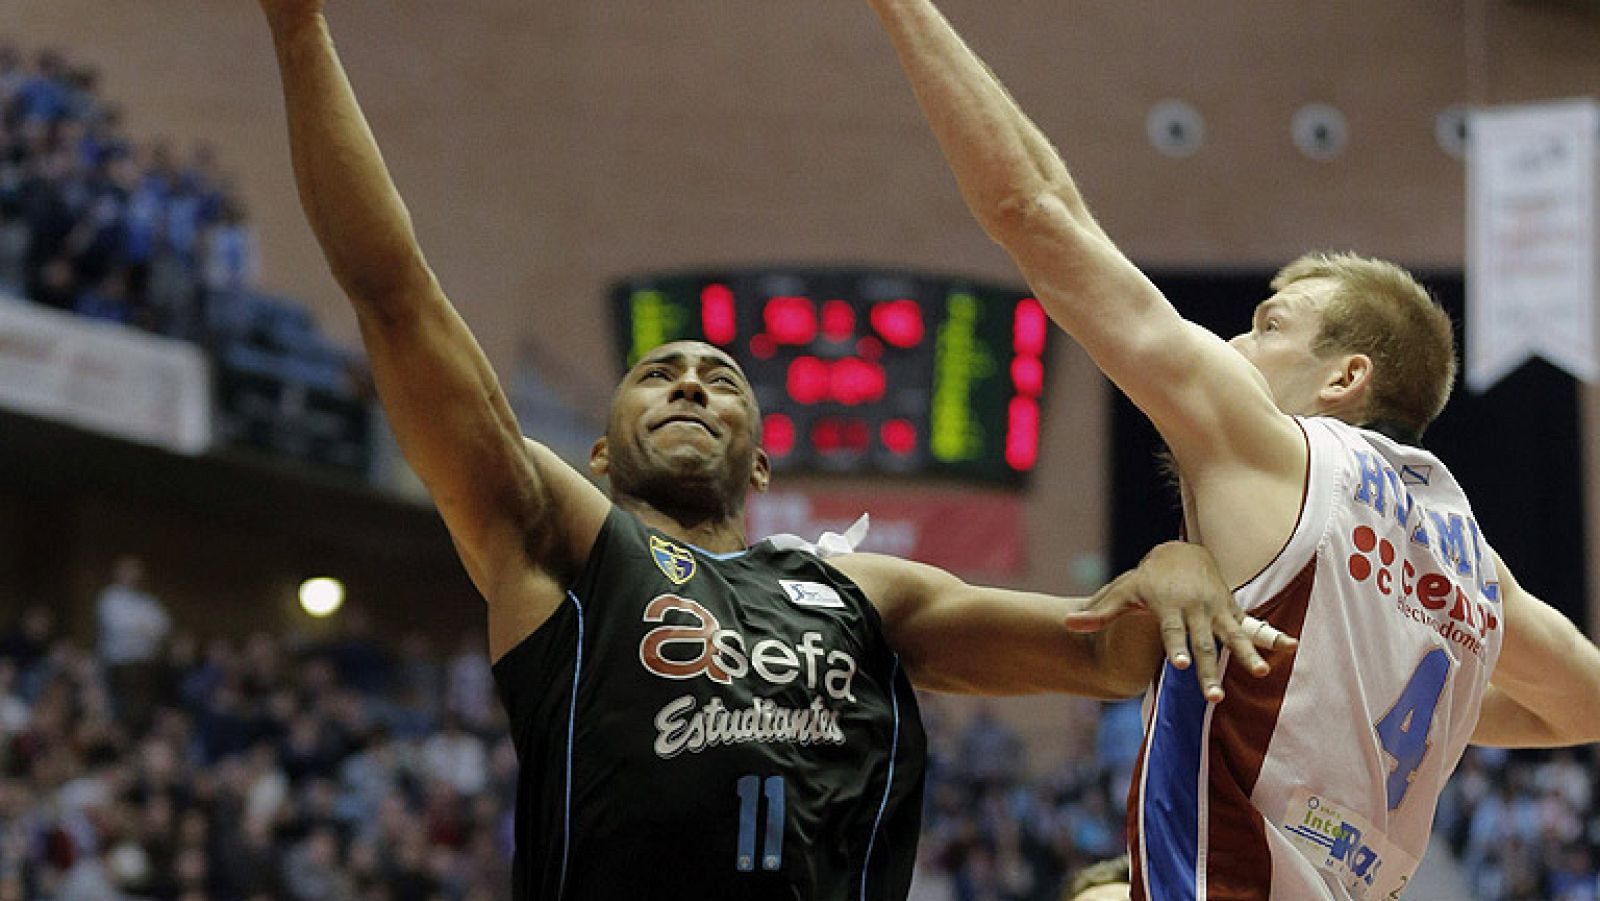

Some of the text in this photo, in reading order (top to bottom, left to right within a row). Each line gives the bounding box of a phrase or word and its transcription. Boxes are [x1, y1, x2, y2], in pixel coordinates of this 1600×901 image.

[640, 594, 857, 702] asefa
[1375, 648, 1450, 812] 4
[736, 775, 787, 872] 11
